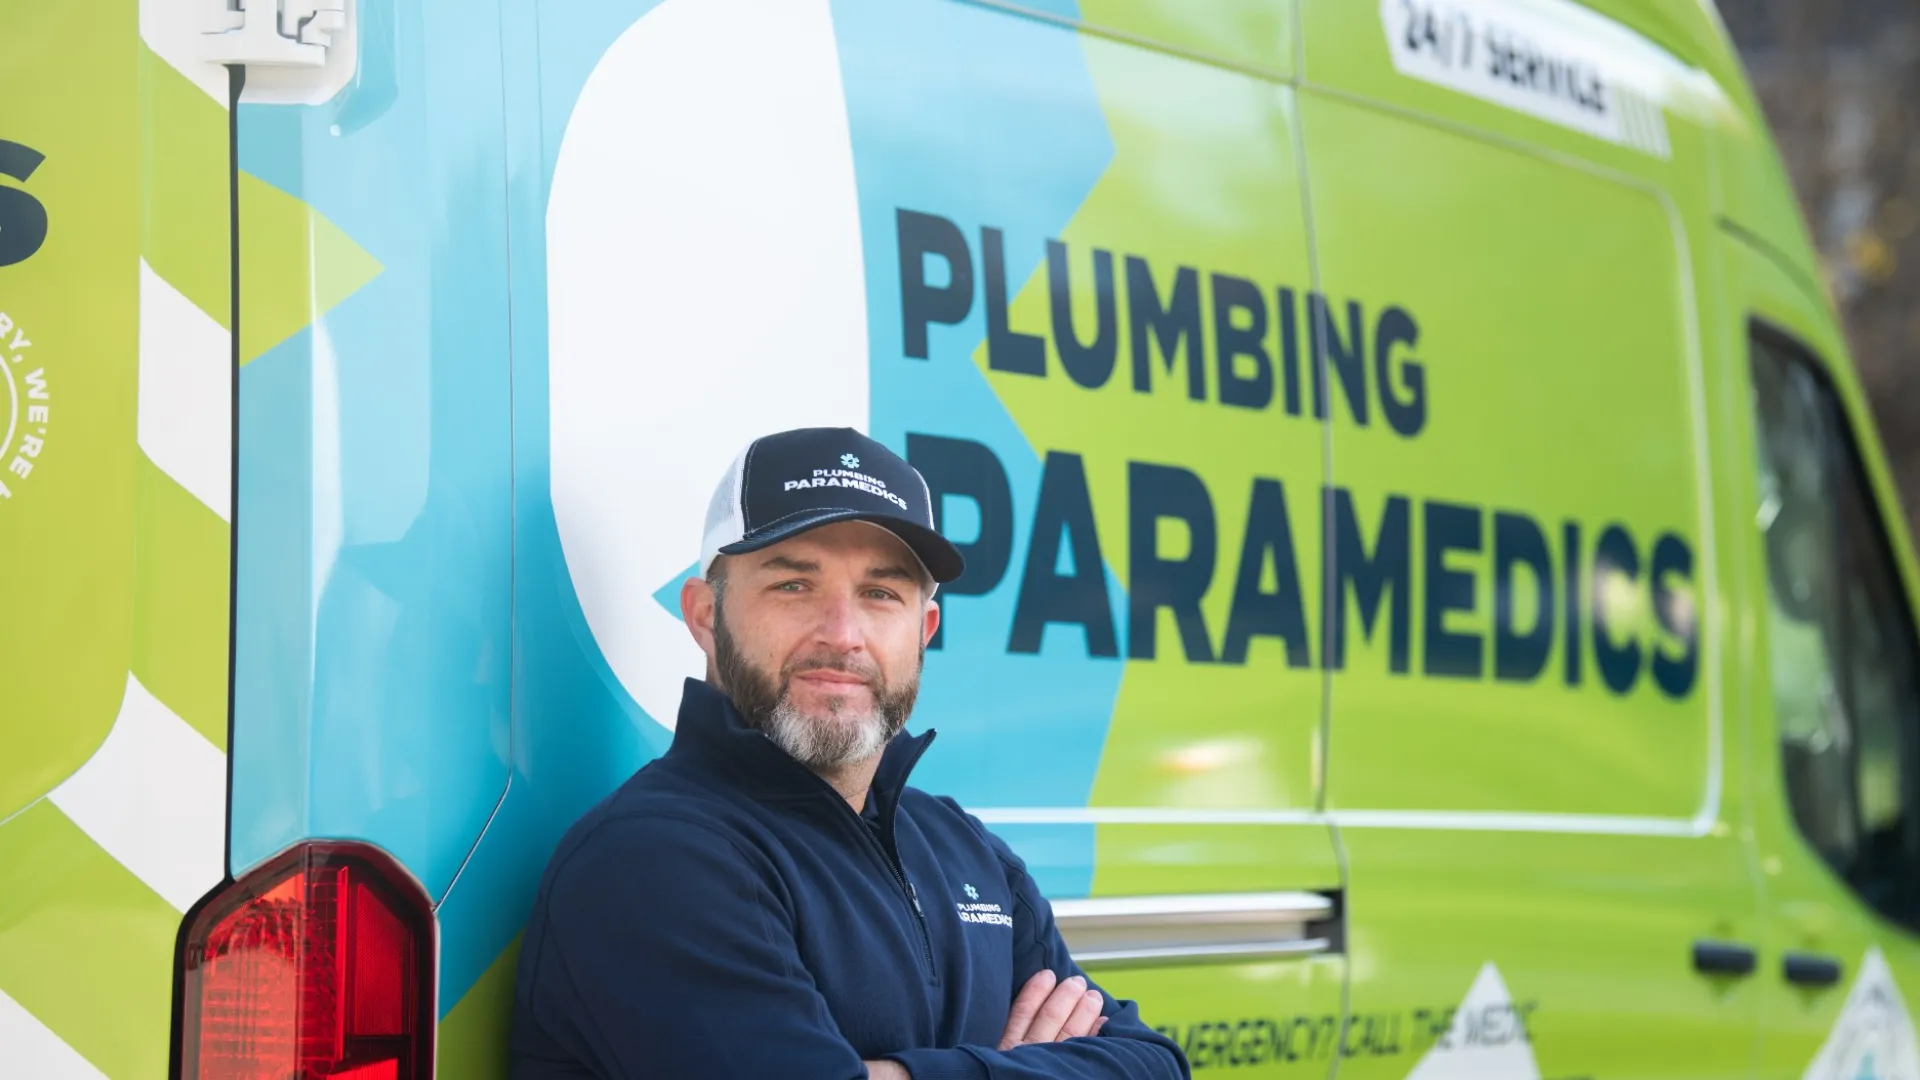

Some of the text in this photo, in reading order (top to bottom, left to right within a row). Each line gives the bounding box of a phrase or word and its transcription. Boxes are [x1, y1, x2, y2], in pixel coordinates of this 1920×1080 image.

[895, 207, 1428, 438] PLUMBING
[9, 367, 50, 479] WE'RE
[783, 477, 908, 511] PARAMEDICS
[812, 469, 886, 489] PLUMBING
[905, 432, 1700, 702] PARAMEDICS
[957, 902, 1002, 913] PLUMBING
